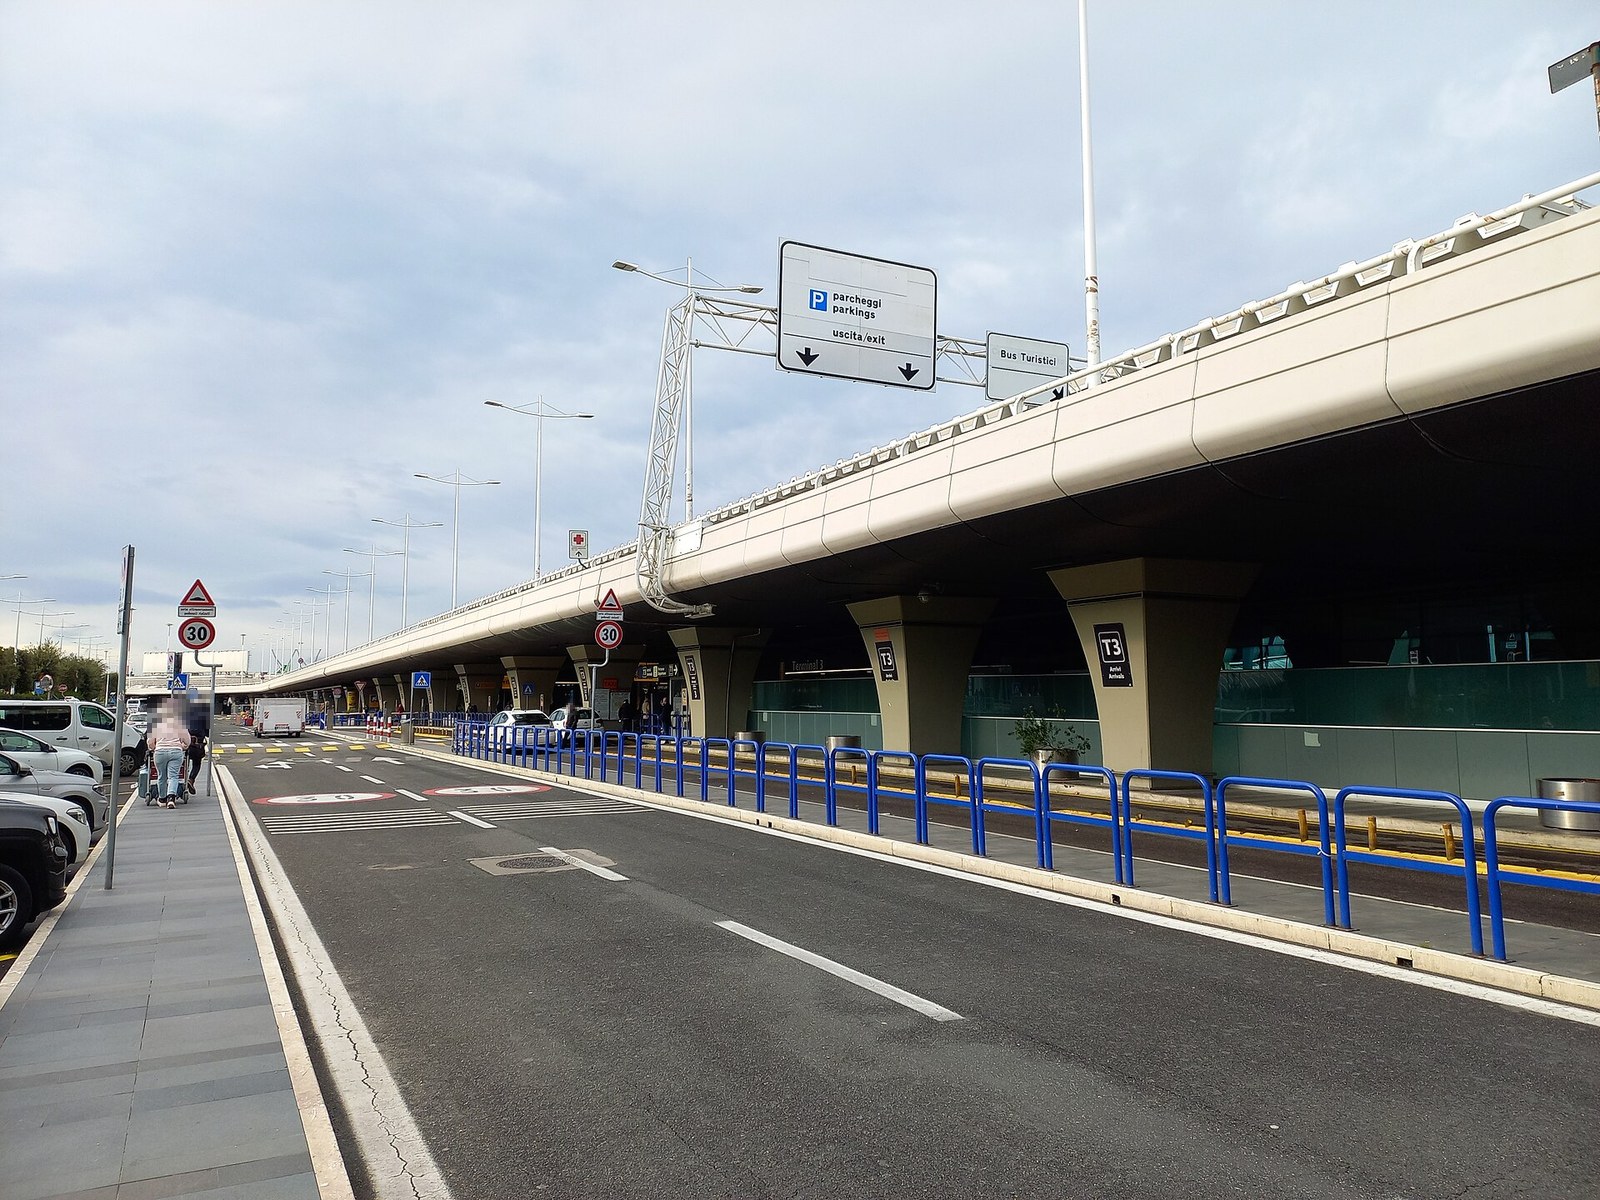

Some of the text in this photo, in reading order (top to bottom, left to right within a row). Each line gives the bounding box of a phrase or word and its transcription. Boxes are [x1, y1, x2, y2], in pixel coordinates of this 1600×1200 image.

[812, 291, 824, 309] P
[832, 292, 882, 309] parcheggi
[832, 304, 876, 320] parkings
[832, 329, 886, 345] uscita/exit
[1000, 349, 1057, 366] Bus Turistici
[187, 626, 208, 641] 30
[601, 628, 617, 641] 30
[1101, 638, 1122, 656] T3
[791, 659, 824, 671] Terminal 3
[880, 652, 893, 666] T3
